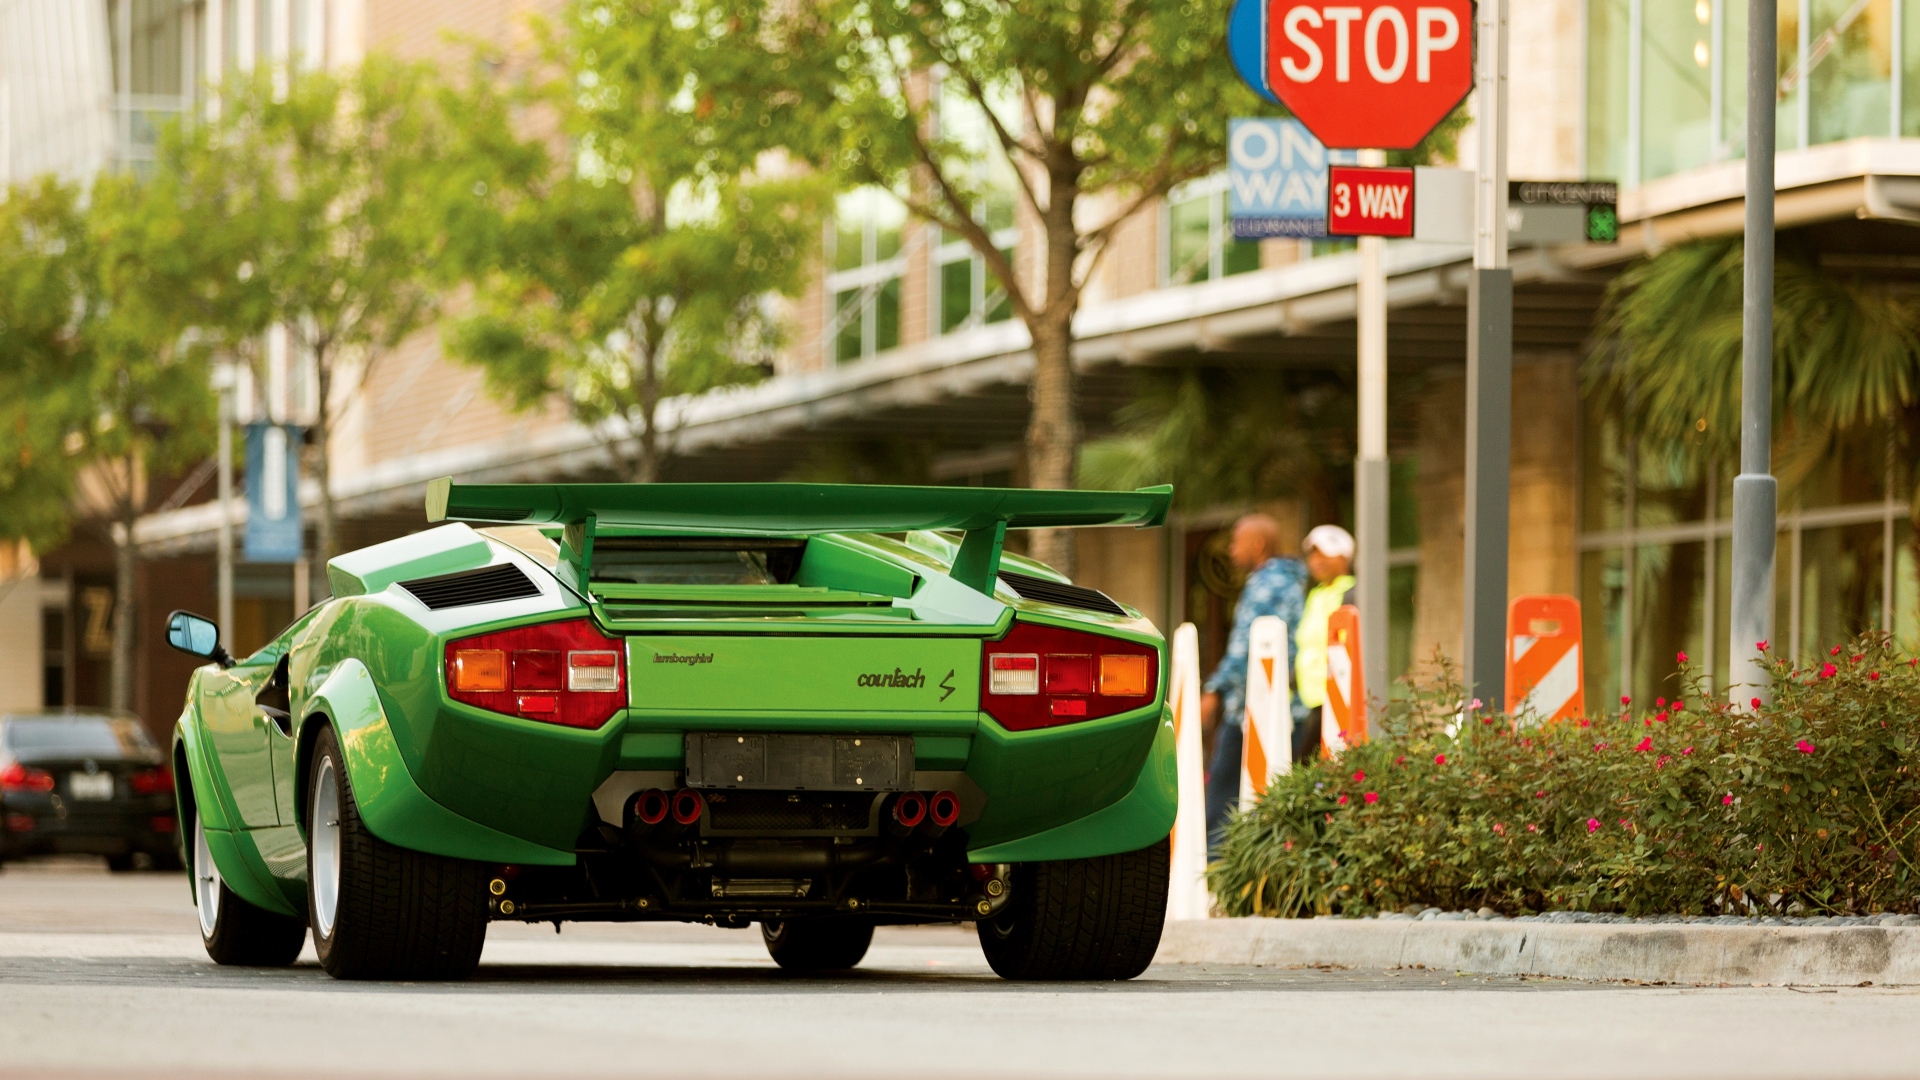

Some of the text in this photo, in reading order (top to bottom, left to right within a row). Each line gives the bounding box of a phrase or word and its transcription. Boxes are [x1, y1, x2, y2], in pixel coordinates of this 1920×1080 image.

[1280, 6, 1459, 84] STOP
[1334, 183, 1409, 219] 3 WAY
[653, 652, 714, 666] lamborghini
[857, 667, 926, 688] countach
